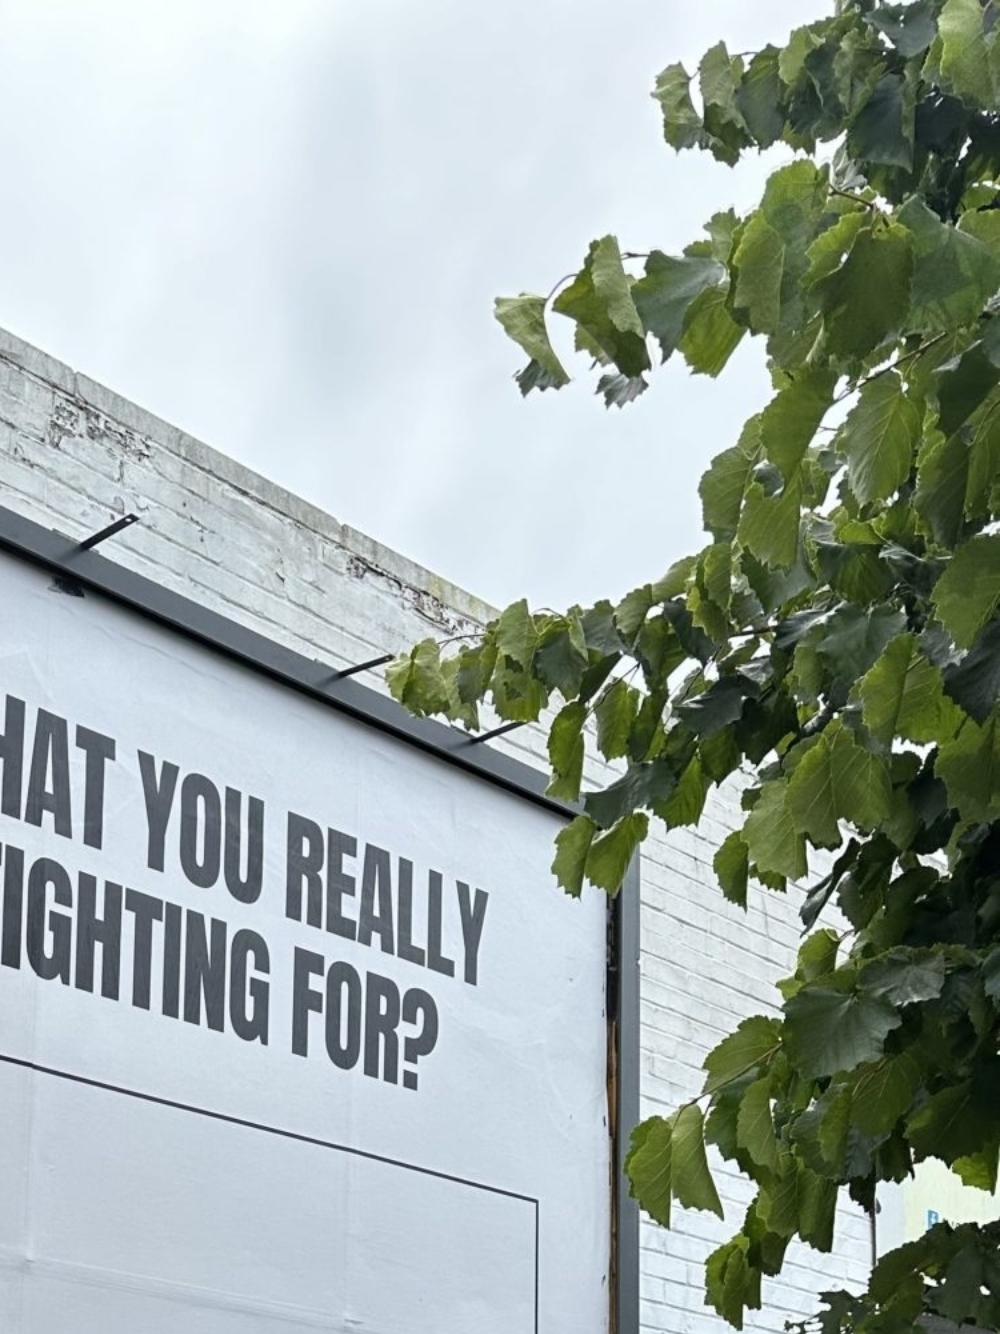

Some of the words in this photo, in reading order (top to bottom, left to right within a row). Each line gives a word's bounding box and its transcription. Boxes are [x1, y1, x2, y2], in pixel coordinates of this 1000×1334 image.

[137, 749, 265, 904] YOU
[285, 811, 489, 986] REALLY
[292, 945, 439, 1091] FOR?
